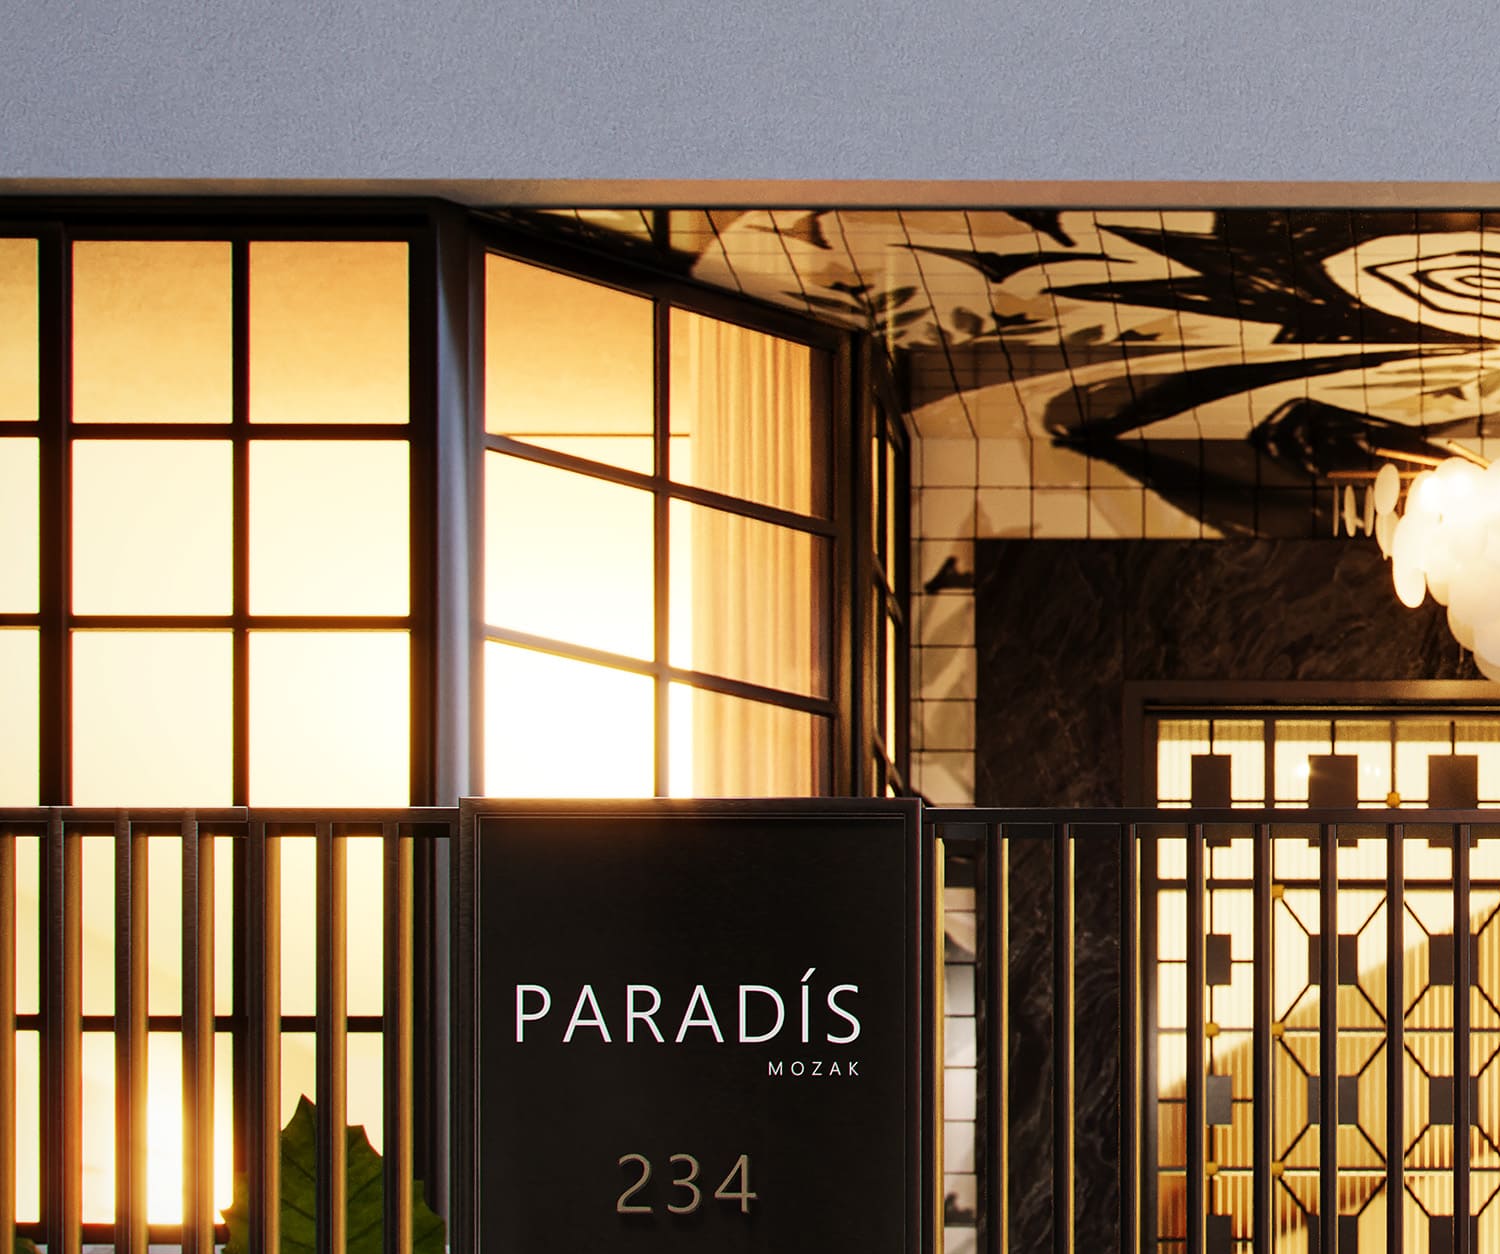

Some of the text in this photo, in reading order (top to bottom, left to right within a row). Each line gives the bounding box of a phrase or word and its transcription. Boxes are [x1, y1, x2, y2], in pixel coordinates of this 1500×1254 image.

[515, 967, 862, 1045] PARADÍS
[767, 1060, 861, 1077] MOZAK
[615, 1153, 759, 1215] 234
